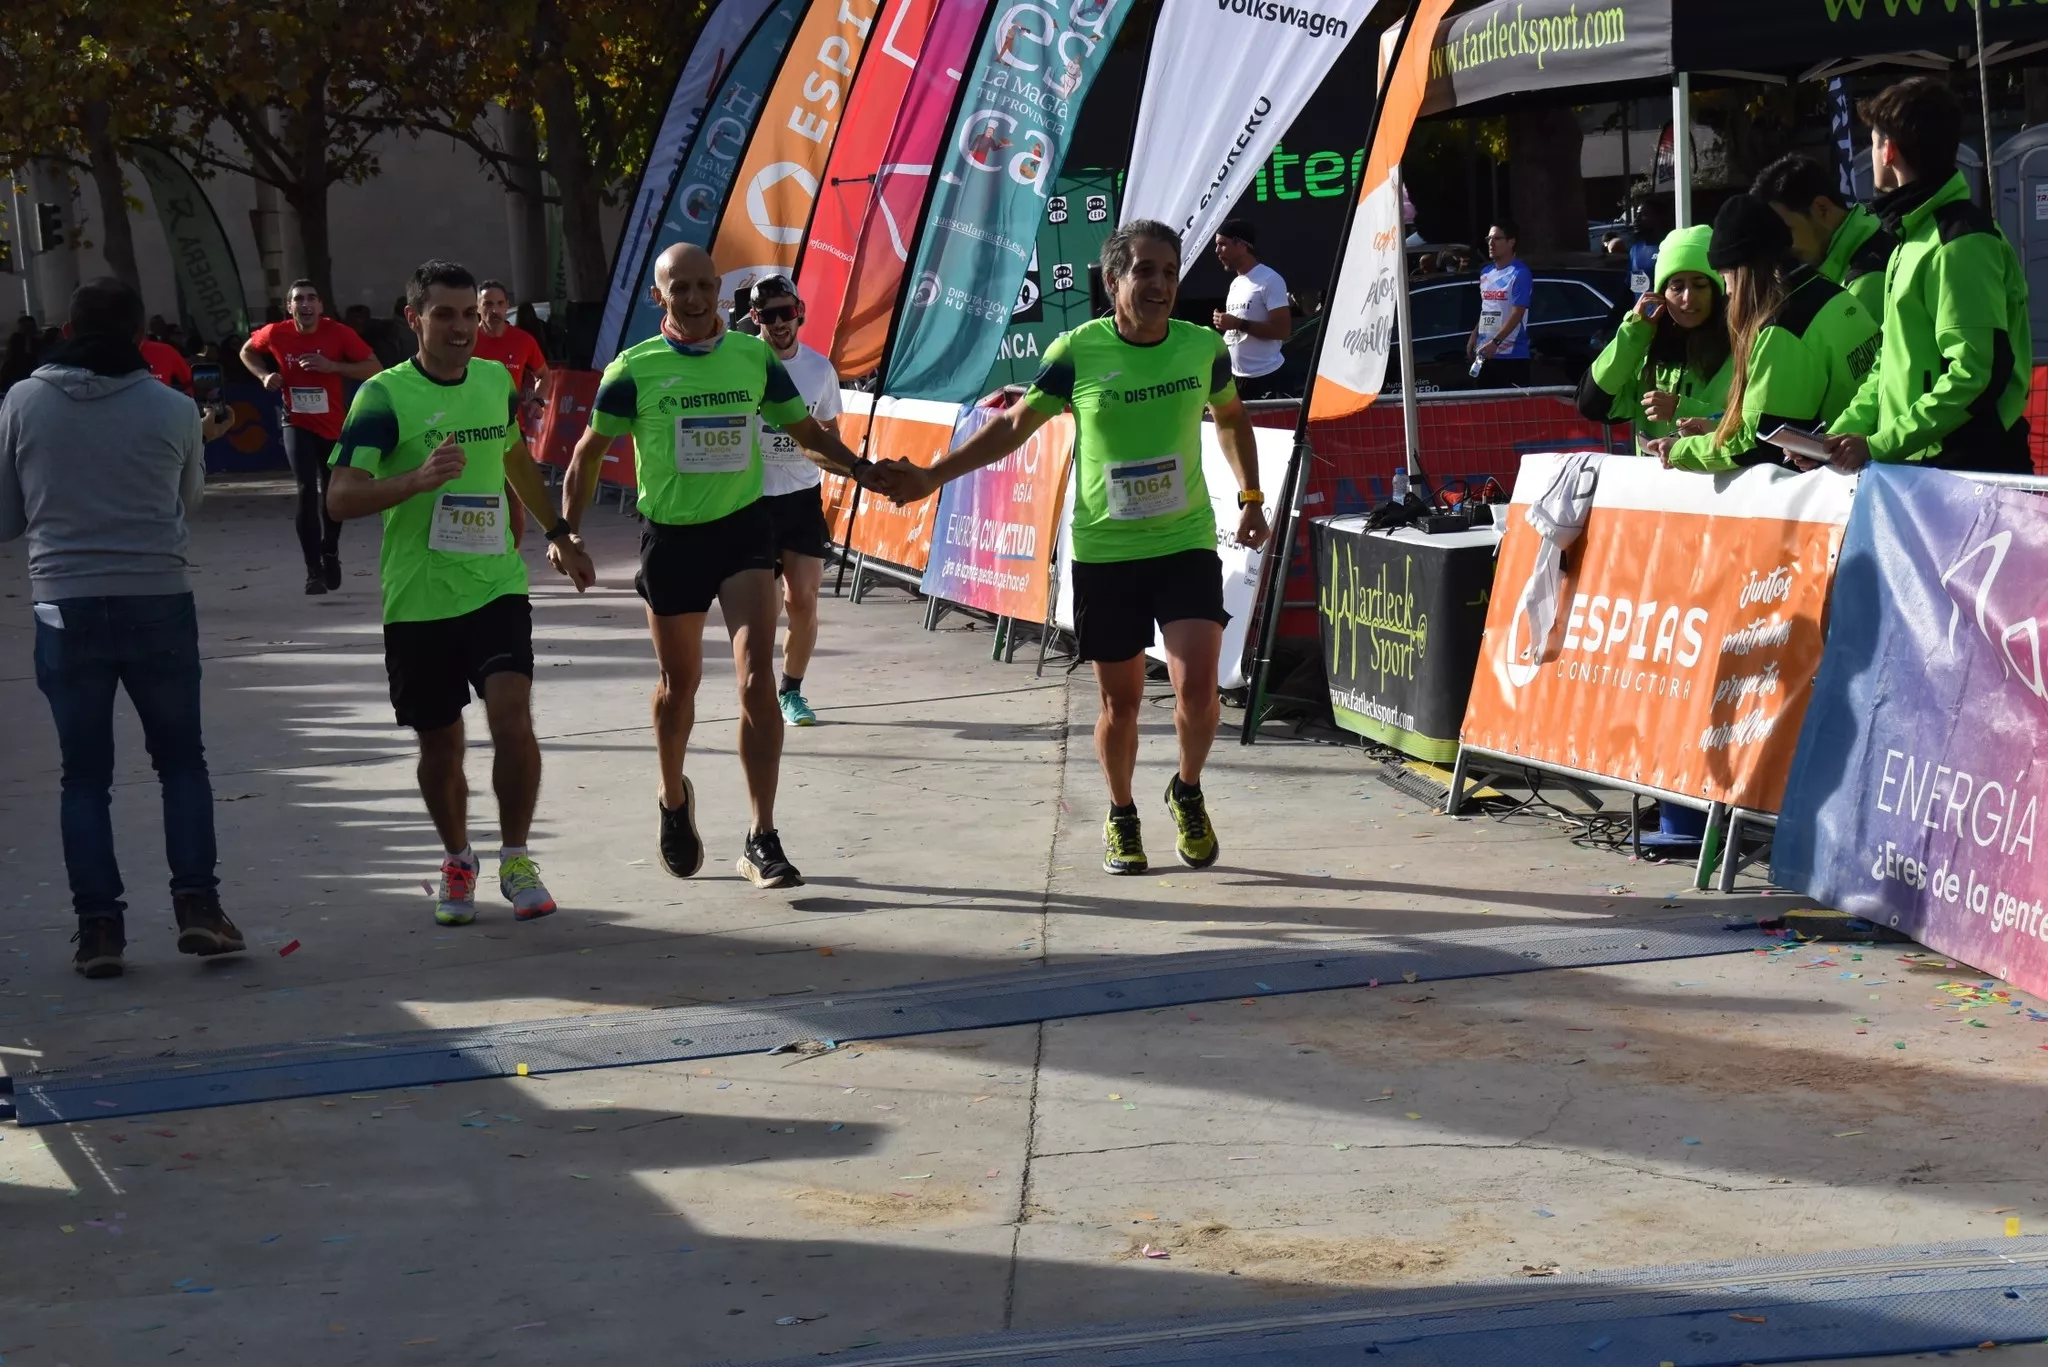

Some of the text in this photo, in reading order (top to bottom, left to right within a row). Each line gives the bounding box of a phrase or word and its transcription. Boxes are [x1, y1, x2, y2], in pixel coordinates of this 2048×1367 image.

[945, 297, 1003, 325] HUESCA
[949, 287, 1008, 315] DIPUTACIÓN
[998, 332, 1039, 361] NCA
[680, 389, 753, 409] DISTROMEL
[1124, 375, 1203, 403] DISTROMEL
[691, 430, 742, 447] 1065
[1123, 474, 1172, 497] 1064
[451, 510, 496, 527] 1063
[1739, 565, 1793, 609] Juntos
[1563, 593, 1709, 668] ESPIAS
[1371, 615, 1415, 693] Sport
[1557, 659, 1692, 700] CONSTRUCTORA
[1877, 748, 2038, 864] ENERGÍA
[1871, 840, 1928, 890] ¿Eres
[1932, 864, 1960, 903] de
[1966, 868, 1989, 915] la
